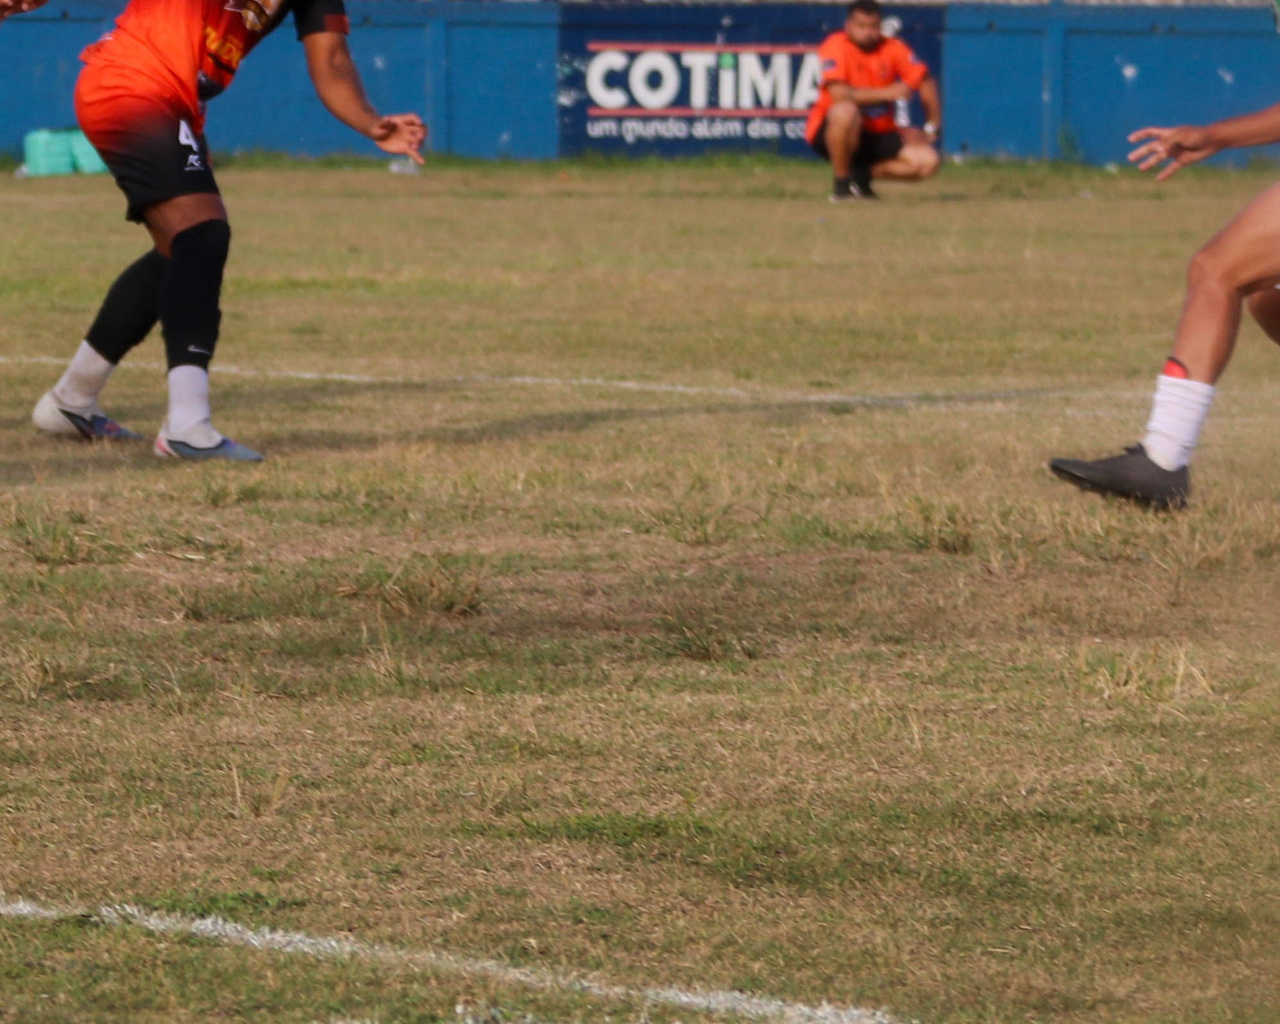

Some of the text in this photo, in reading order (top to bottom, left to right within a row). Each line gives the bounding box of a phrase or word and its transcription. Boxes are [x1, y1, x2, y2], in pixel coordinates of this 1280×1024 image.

[178, 119, 199, 153] 4
[587, 119, 620, 138] um
[747, 117, 781, 139] das
